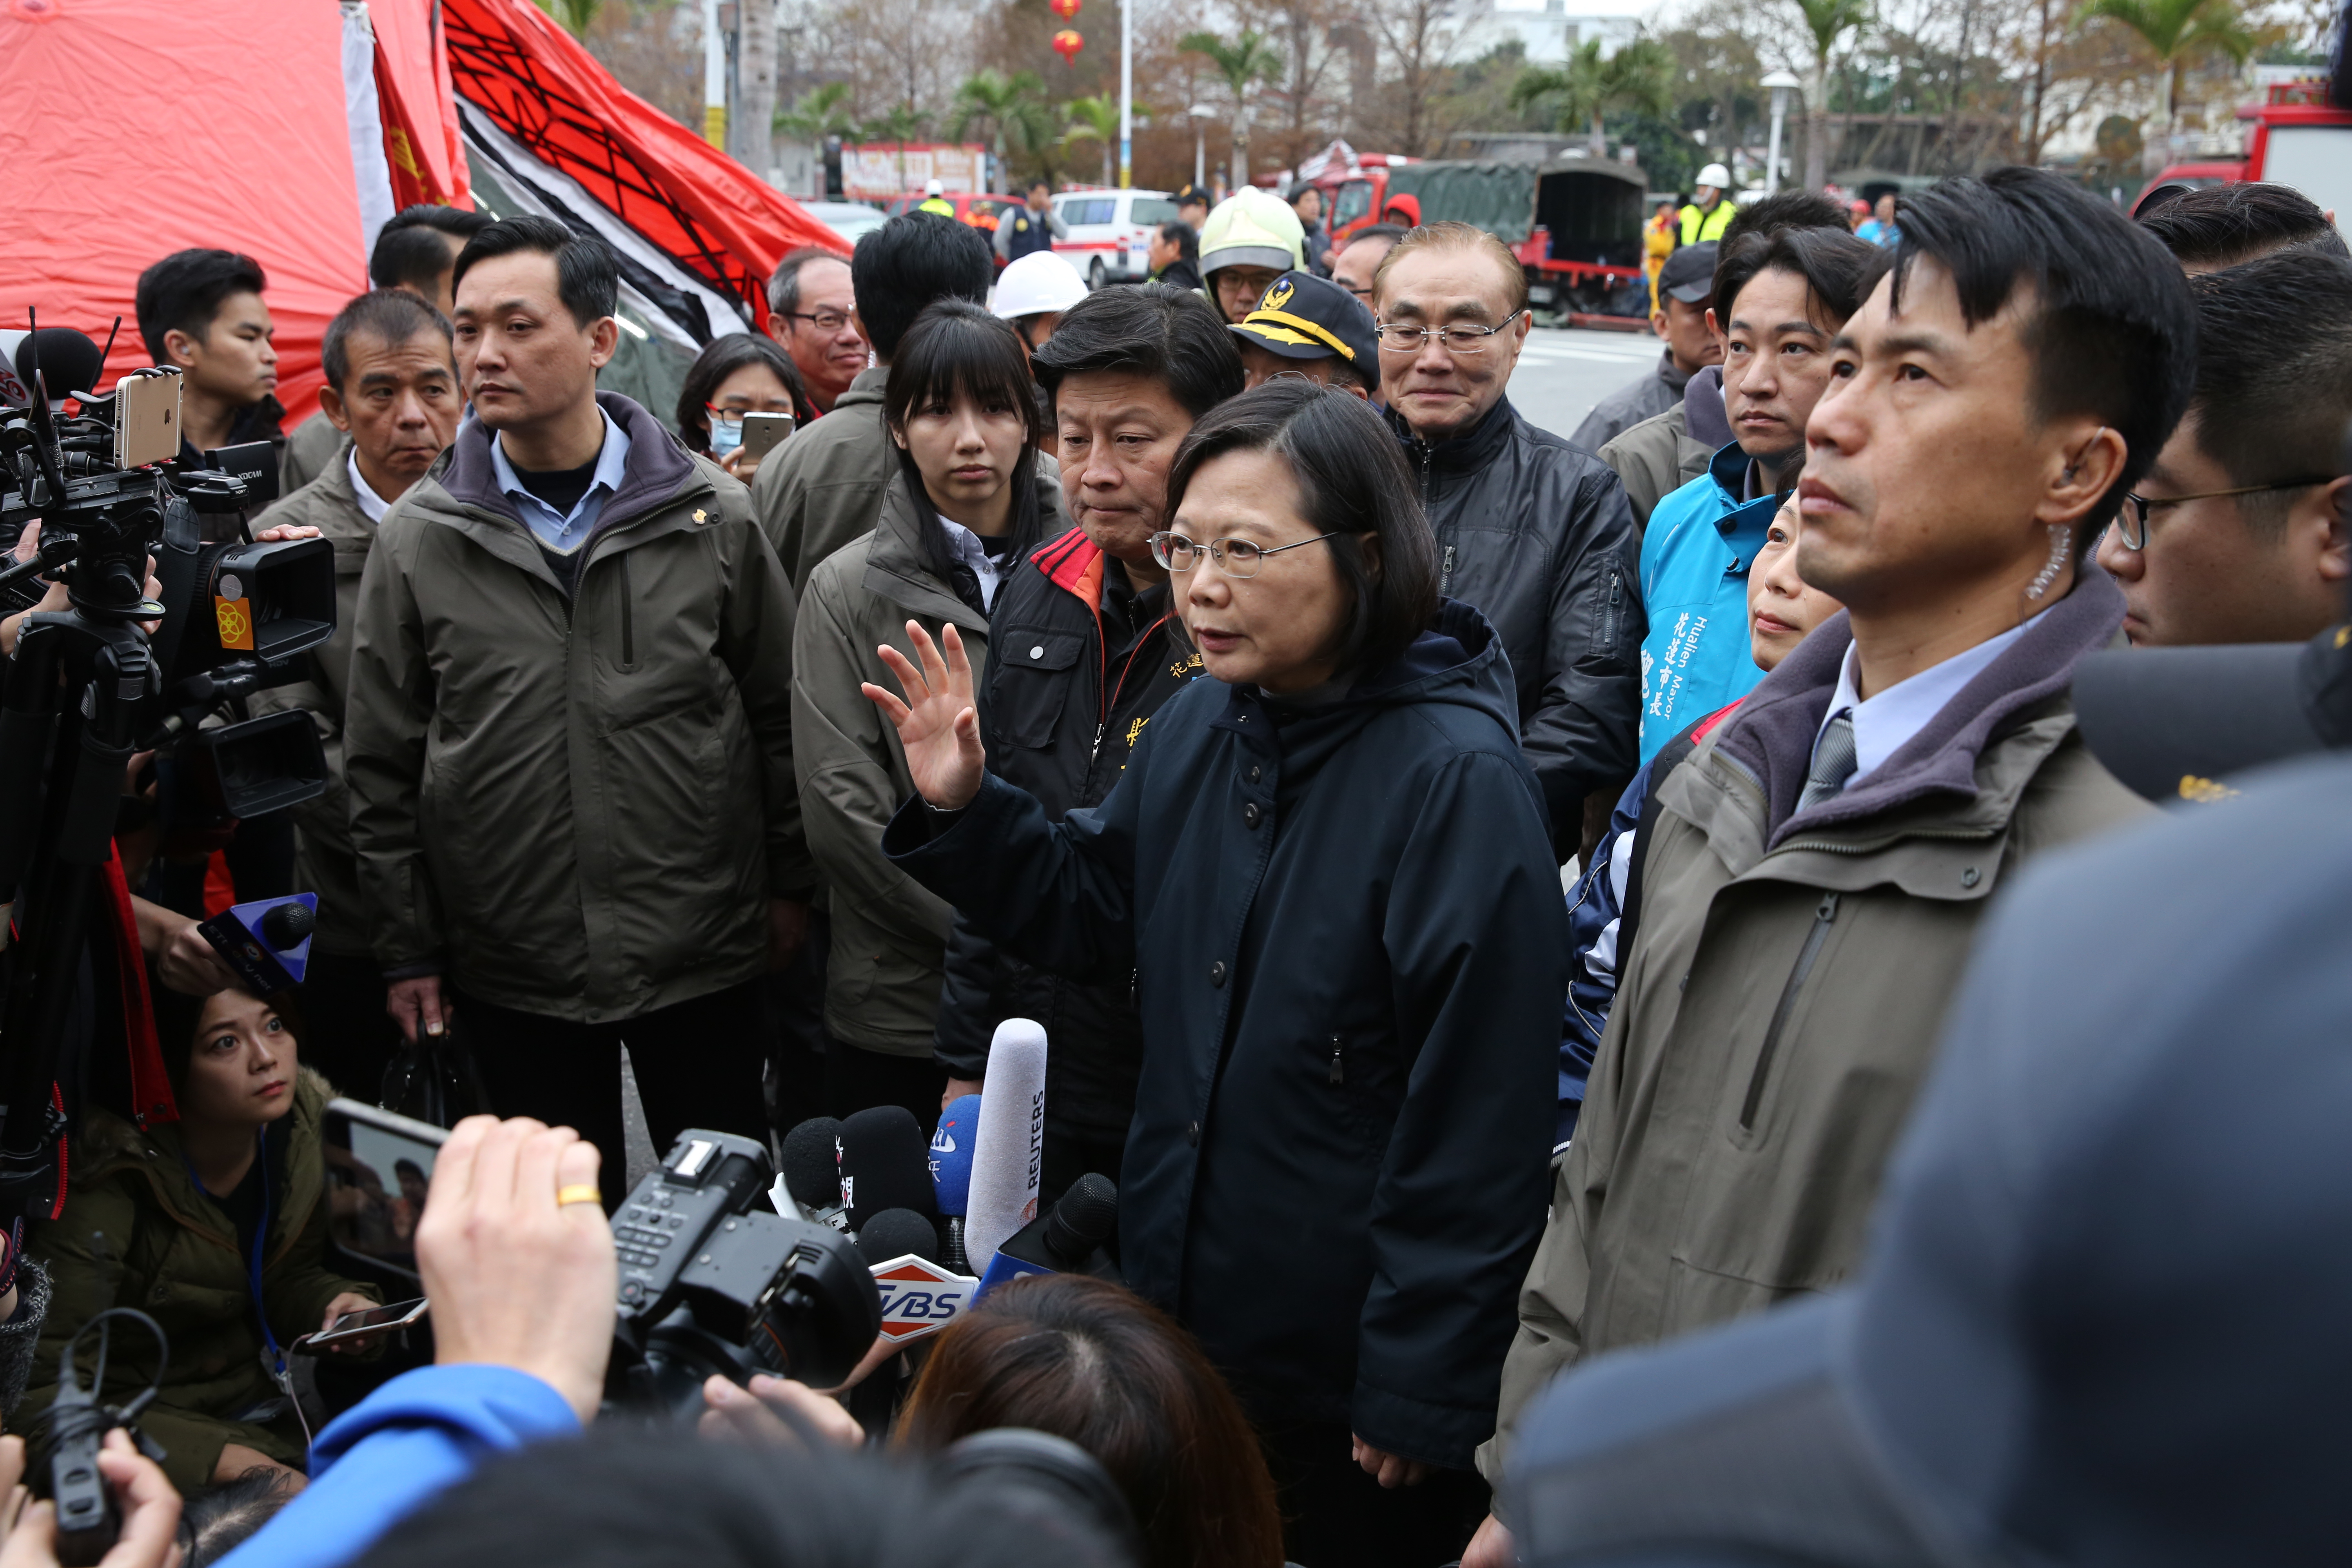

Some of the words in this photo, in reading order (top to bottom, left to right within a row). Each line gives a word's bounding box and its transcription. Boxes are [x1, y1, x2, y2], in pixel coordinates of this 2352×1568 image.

[93, 559, 101, 568] ON
[1677, 616, 1708, 668] Hualien
[1664, 675, 1684, 720] Mayor
[1028, 1089, 1044, 1190] REUTERS
